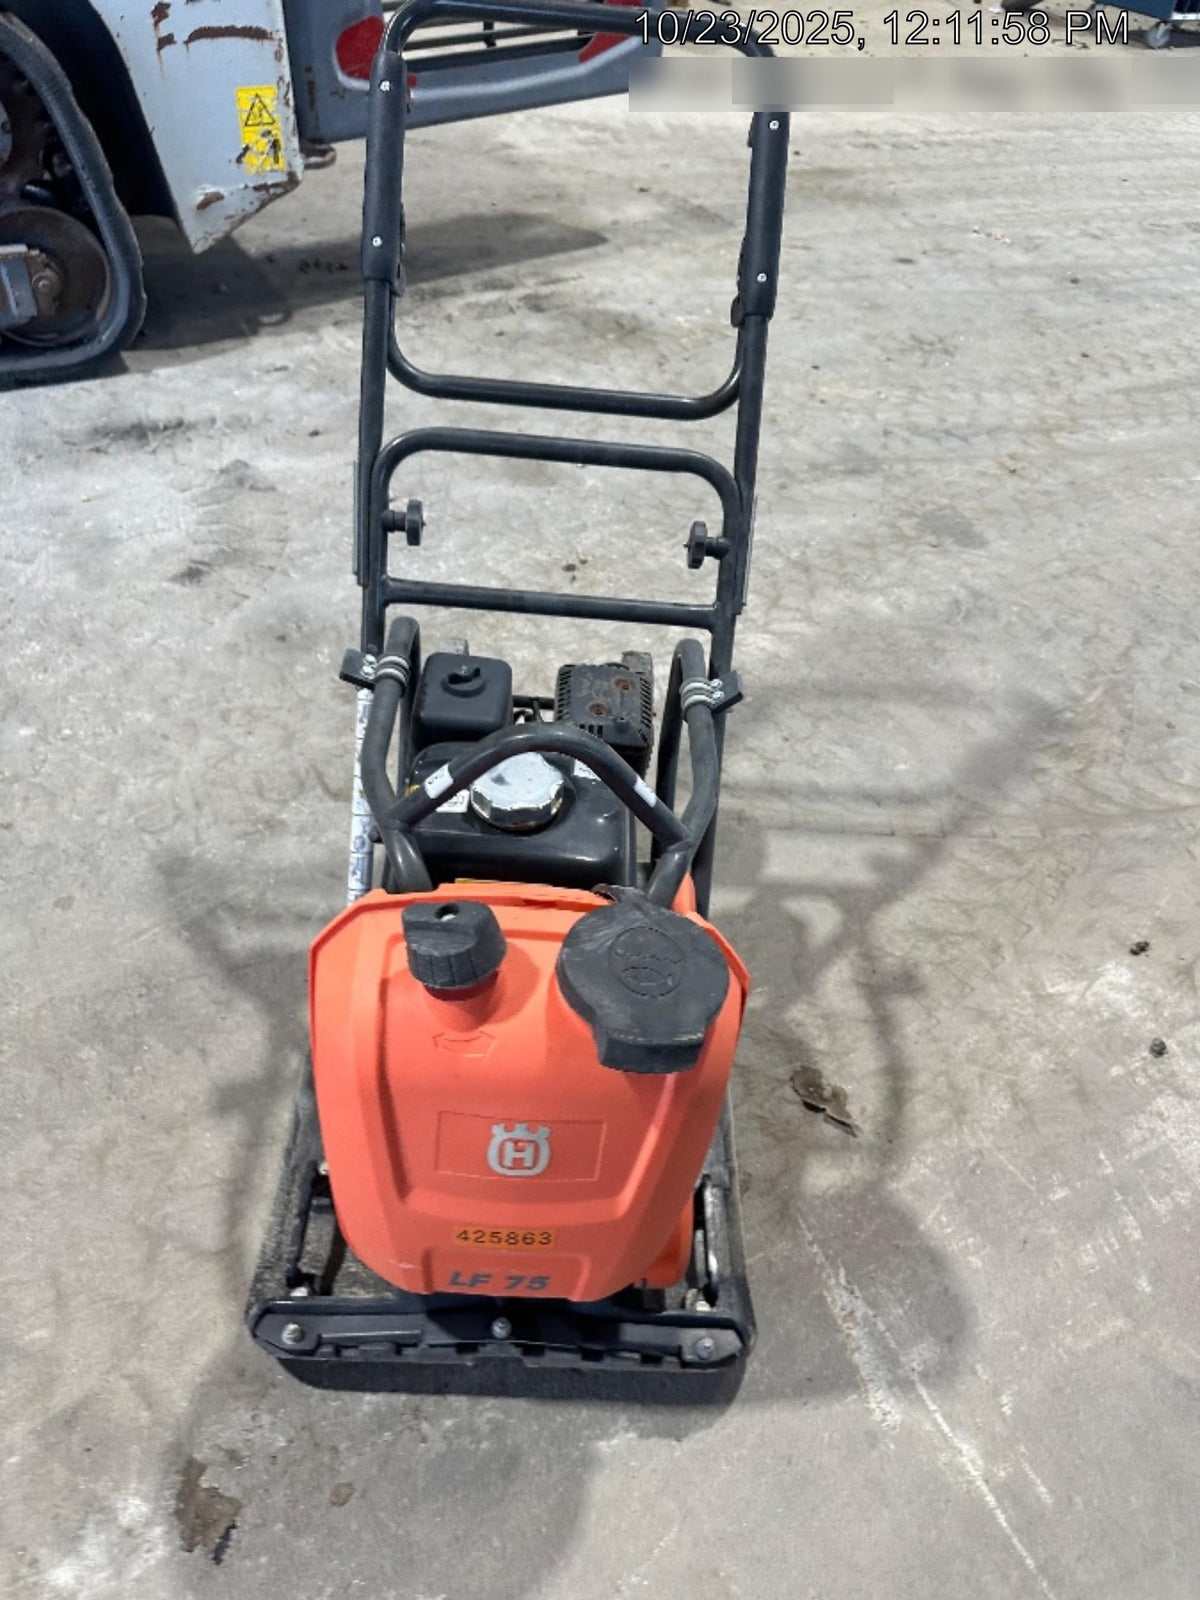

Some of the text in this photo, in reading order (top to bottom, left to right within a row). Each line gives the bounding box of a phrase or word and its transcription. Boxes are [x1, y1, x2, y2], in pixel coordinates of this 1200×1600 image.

[503, 1140, 535, 1168] H
[456, 1229, 552, 1246] 425863
[449, 1270, 550, 1291] LF 75
